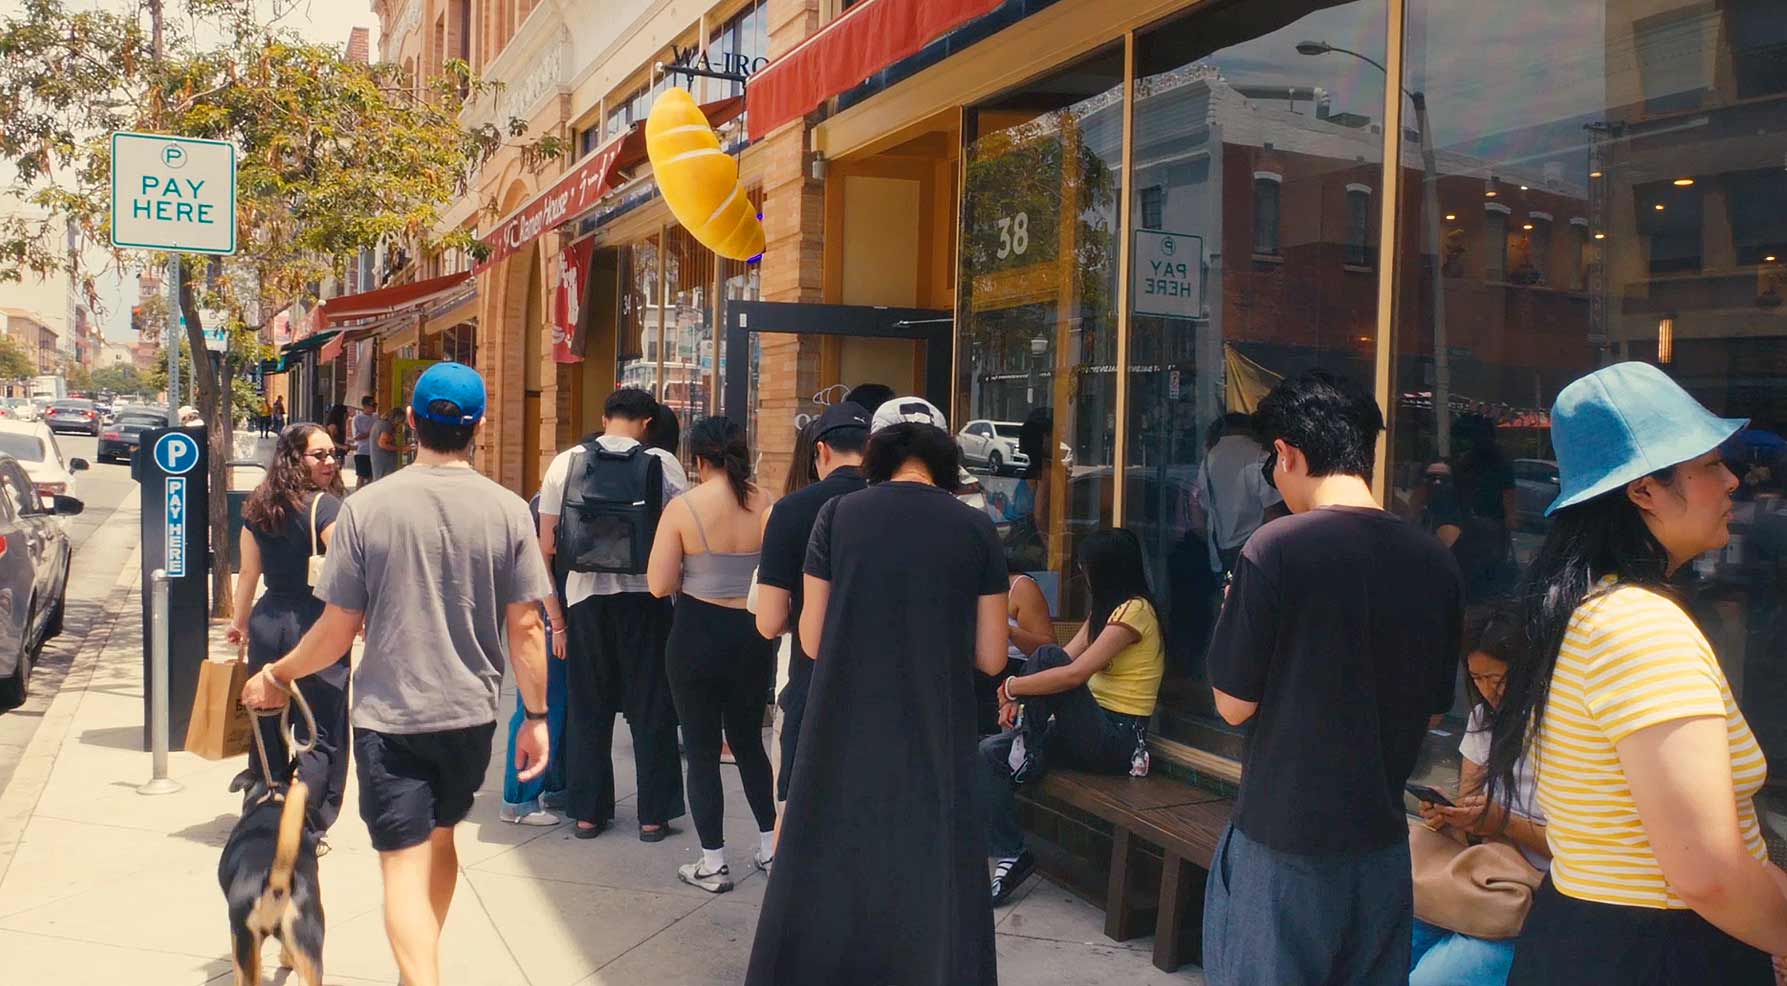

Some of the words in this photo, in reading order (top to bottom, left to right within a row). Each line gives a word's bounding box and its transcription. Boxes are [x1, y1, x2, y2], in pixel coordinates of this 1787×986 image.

[166, 148, 182, 163] P
[142, 175, 205, 199] PAY
[133, 198, 214, 224] HERE
[544, 189, 568, 225] House
[997, 212, 1029, 259] 38
[167, 439, 187, 467] P
[169, 481, 182, 519] PAY
[169, 523, 182, 573] HERE
